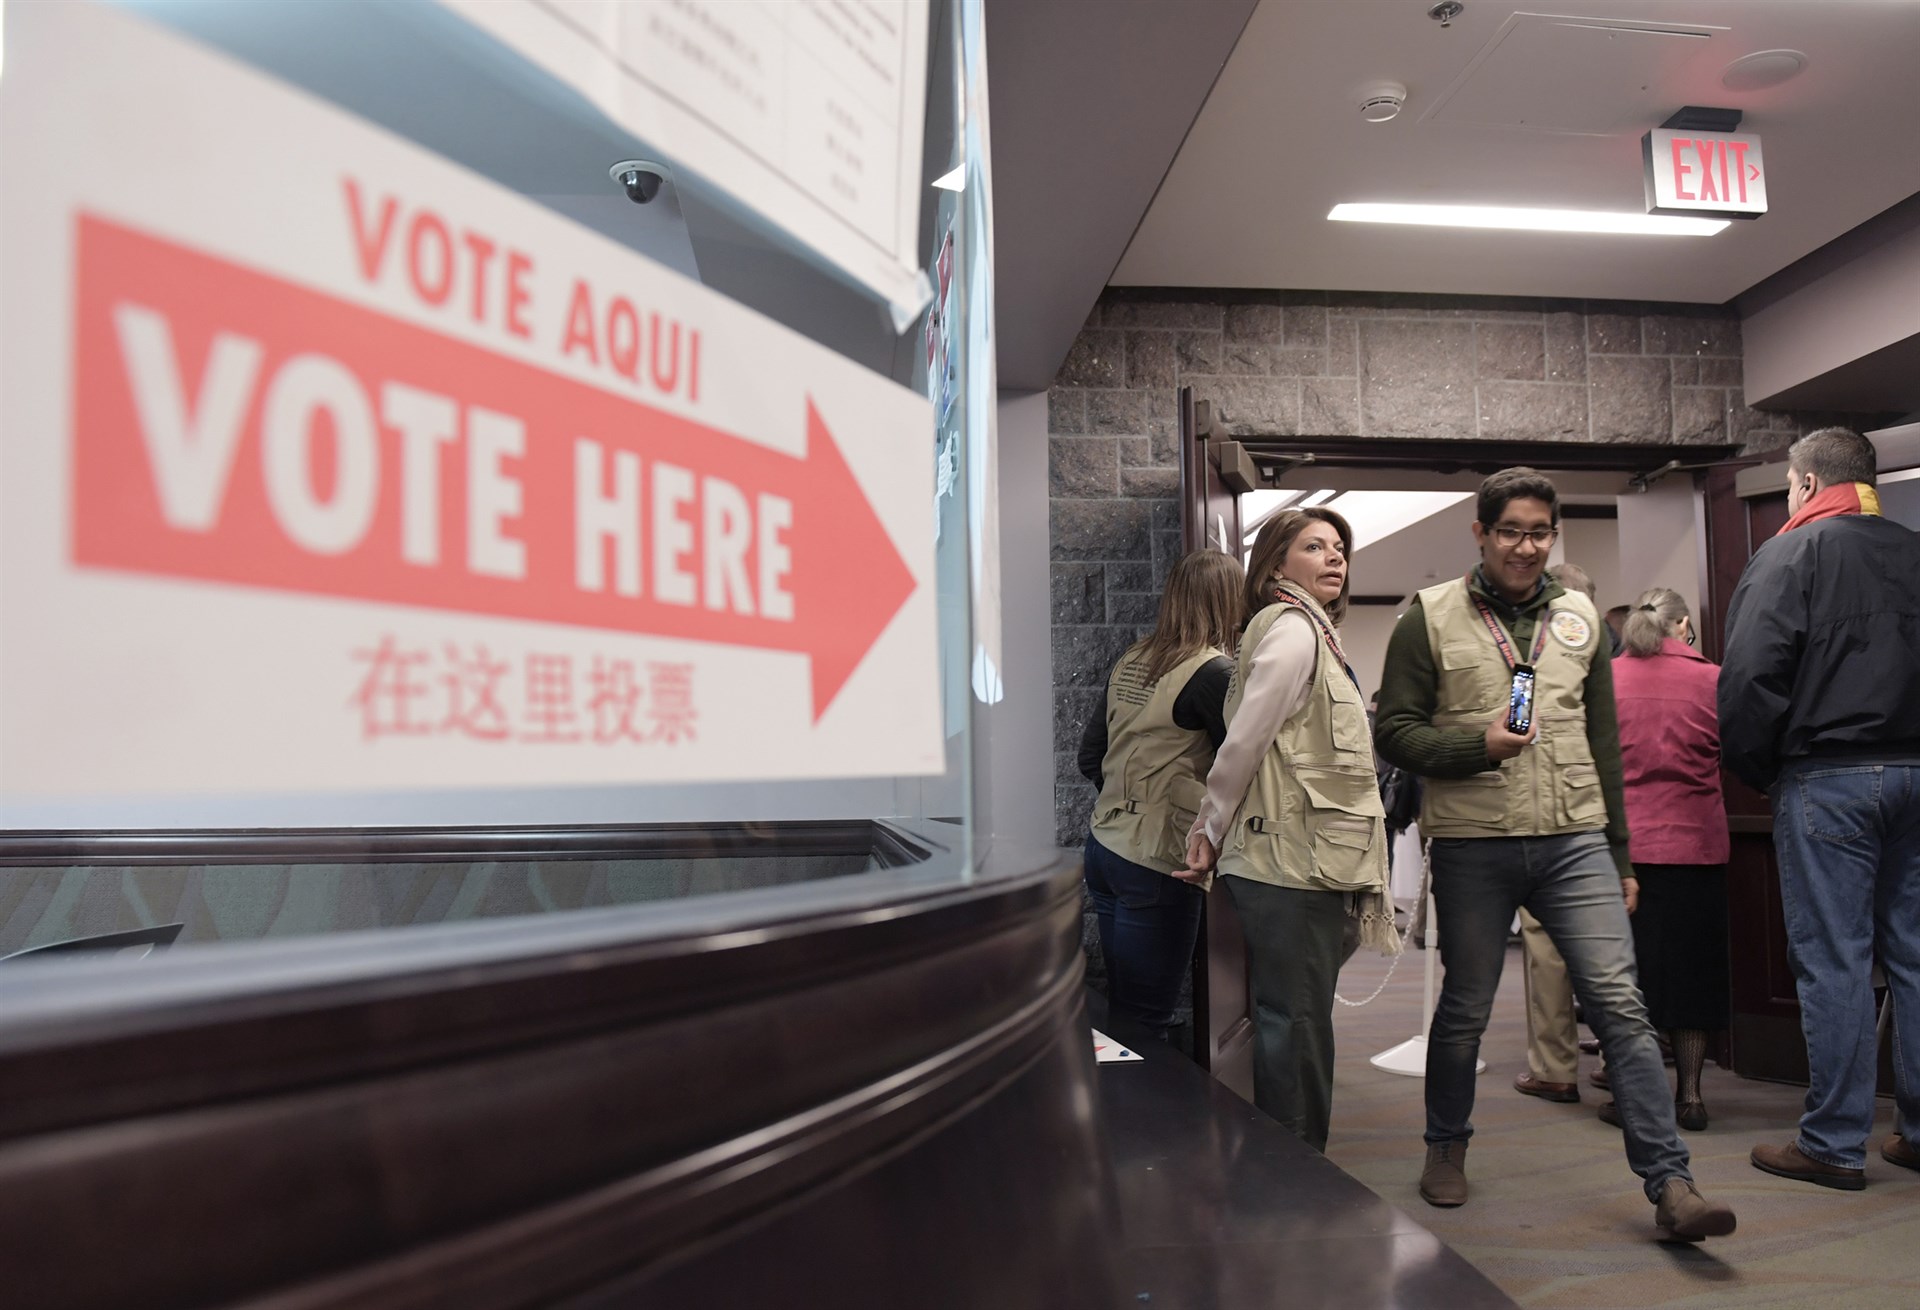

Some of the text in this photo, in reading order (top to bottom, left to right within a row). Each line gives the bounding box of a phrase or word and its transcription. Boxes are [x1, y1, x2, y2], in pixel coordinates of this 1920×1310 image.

[1670, 137, 1749, 203] EXIT
[341, 176, 702, 403] VOTE AQUI
[112, 300, 796, 623] VOTE HERE
[350, 637, 700, 745] 在这里投票
